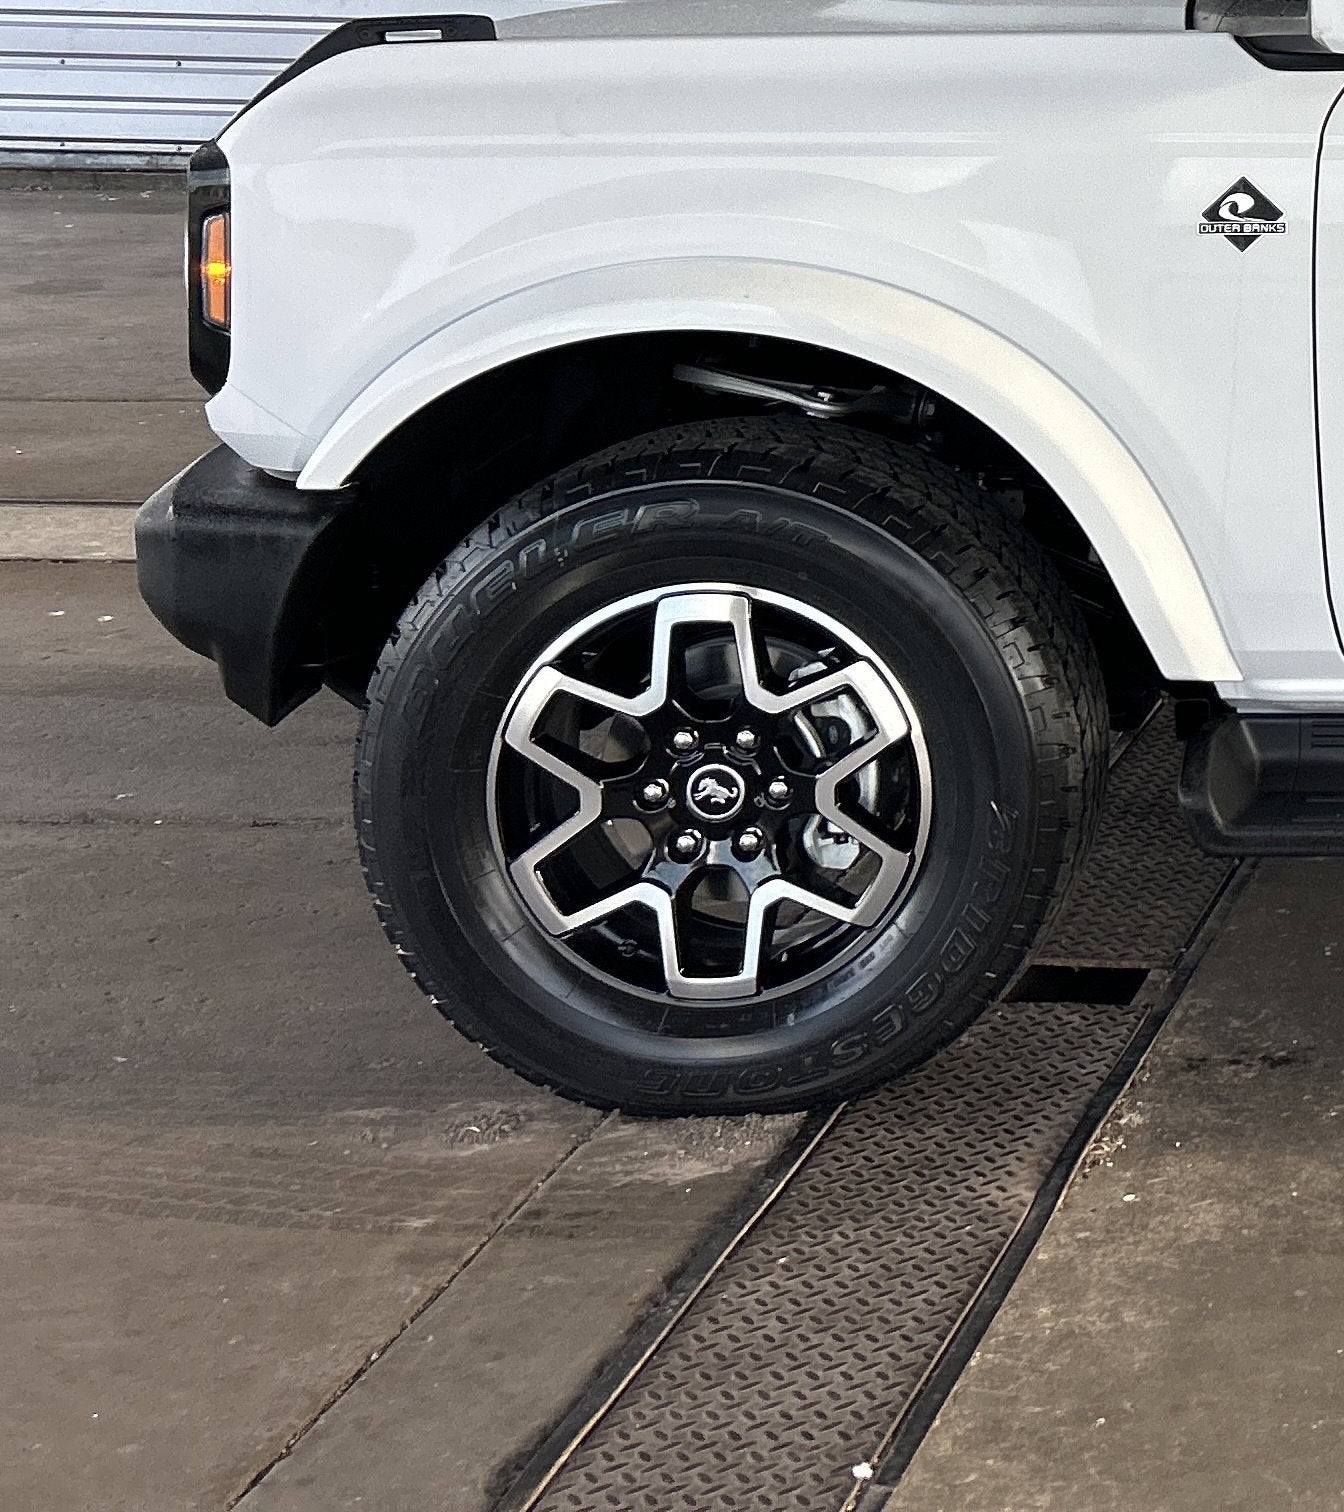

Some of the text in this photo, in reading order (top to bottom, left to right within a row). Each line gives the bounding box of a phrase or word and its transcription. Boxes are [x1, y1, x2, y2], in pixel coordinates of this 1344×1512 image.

[1200, 223, 1285, 233] OUTER BANKS
[637, 798, 1021, 1097] BRIDGESTONE
